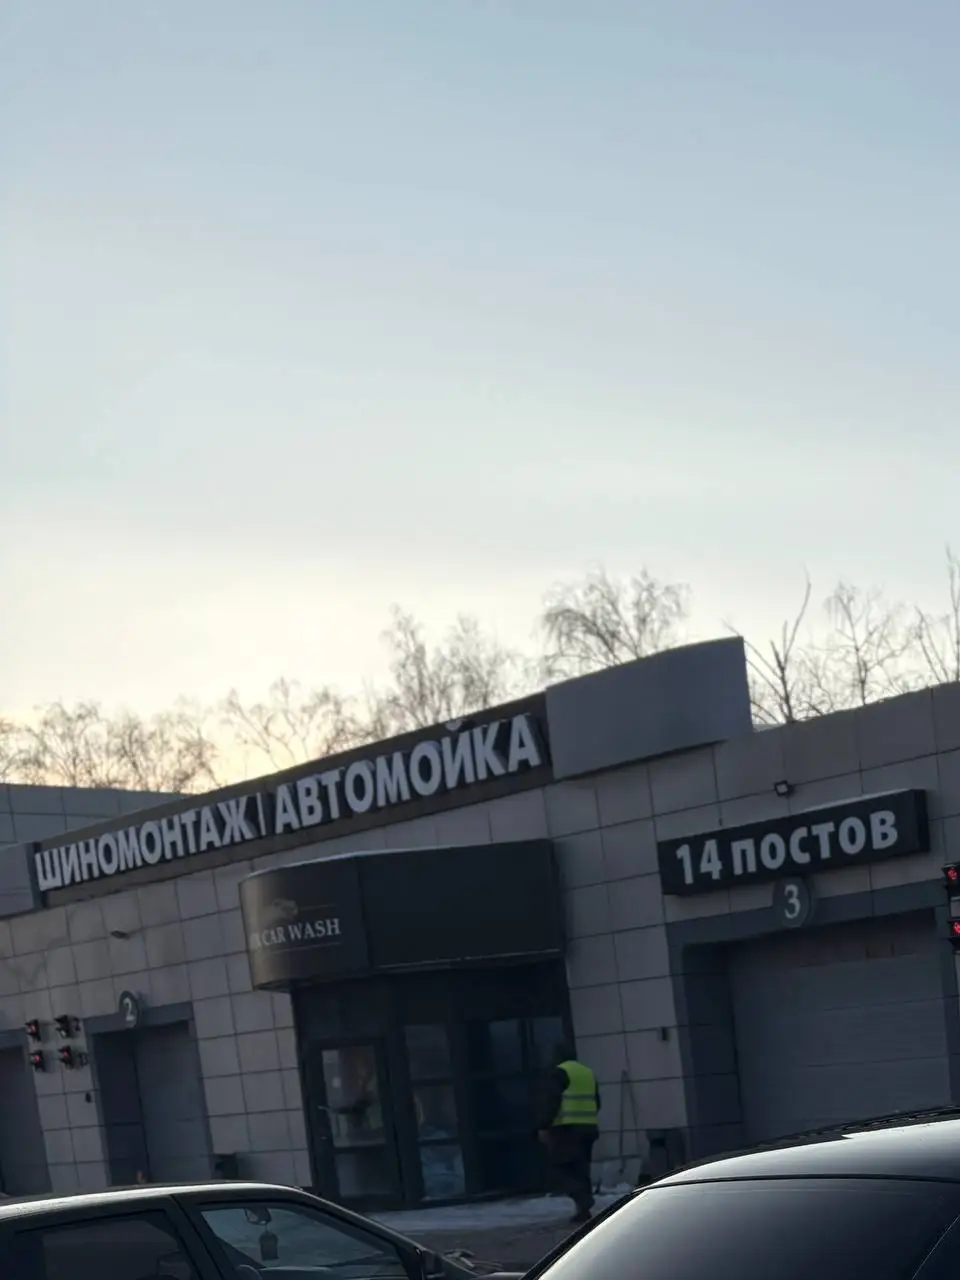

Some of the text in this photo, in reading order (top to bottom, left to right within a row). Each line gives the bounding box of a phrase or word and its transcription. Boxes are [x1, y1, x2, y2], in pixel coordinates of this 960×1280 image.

[34, 712, 542, 891] ШИНОМОНТАЖ АВТОМОЙКА
[676, 838, 723, 885] 14
[783, 883, 801, 919] 3
[261, 926, 287, 946] CAR
[288, 917, 342, 941] WASH
[123, 996, 136, 1022] 2
